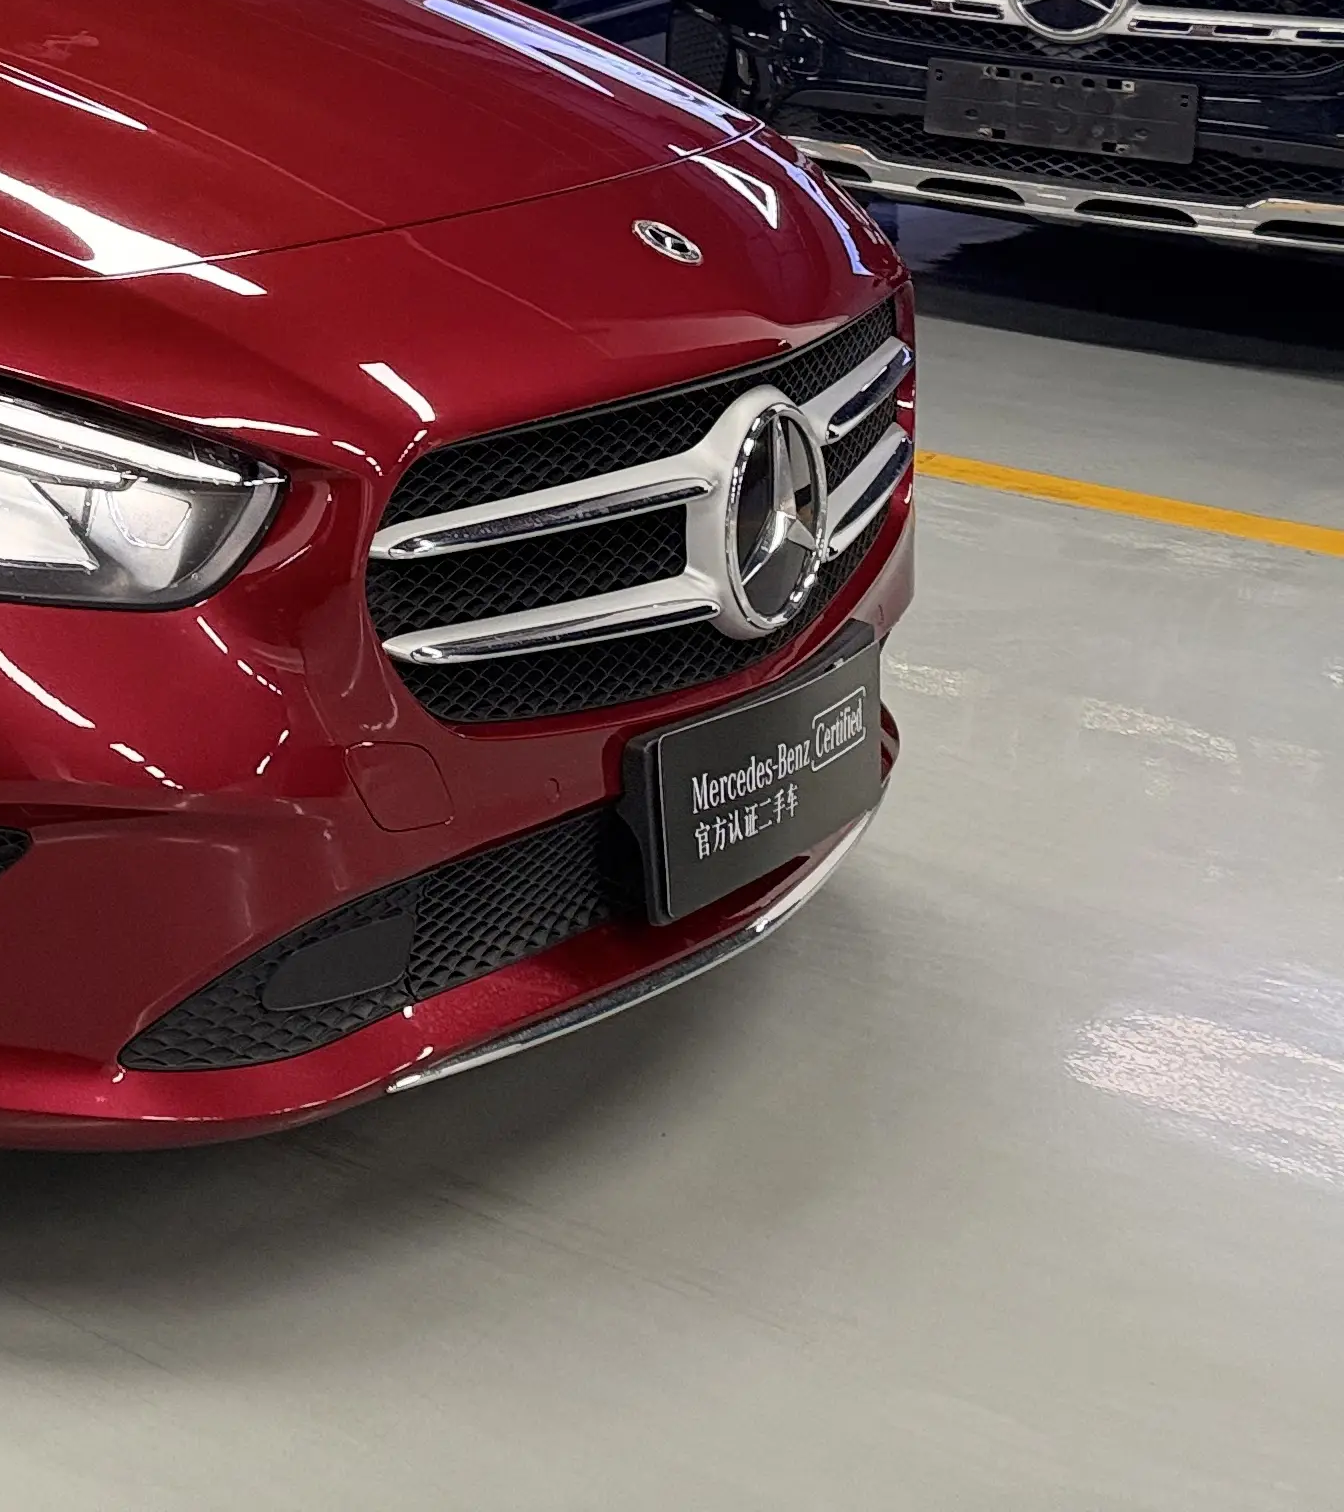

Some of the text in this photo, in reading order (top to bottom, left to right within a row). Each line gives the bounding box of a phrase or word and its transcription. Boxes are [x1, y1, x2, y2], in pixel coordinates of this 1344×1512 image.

[692, 698, 863, 814] Mercedes-Benz Certified
[694, 782, 800, 860] 官方认证二手车
